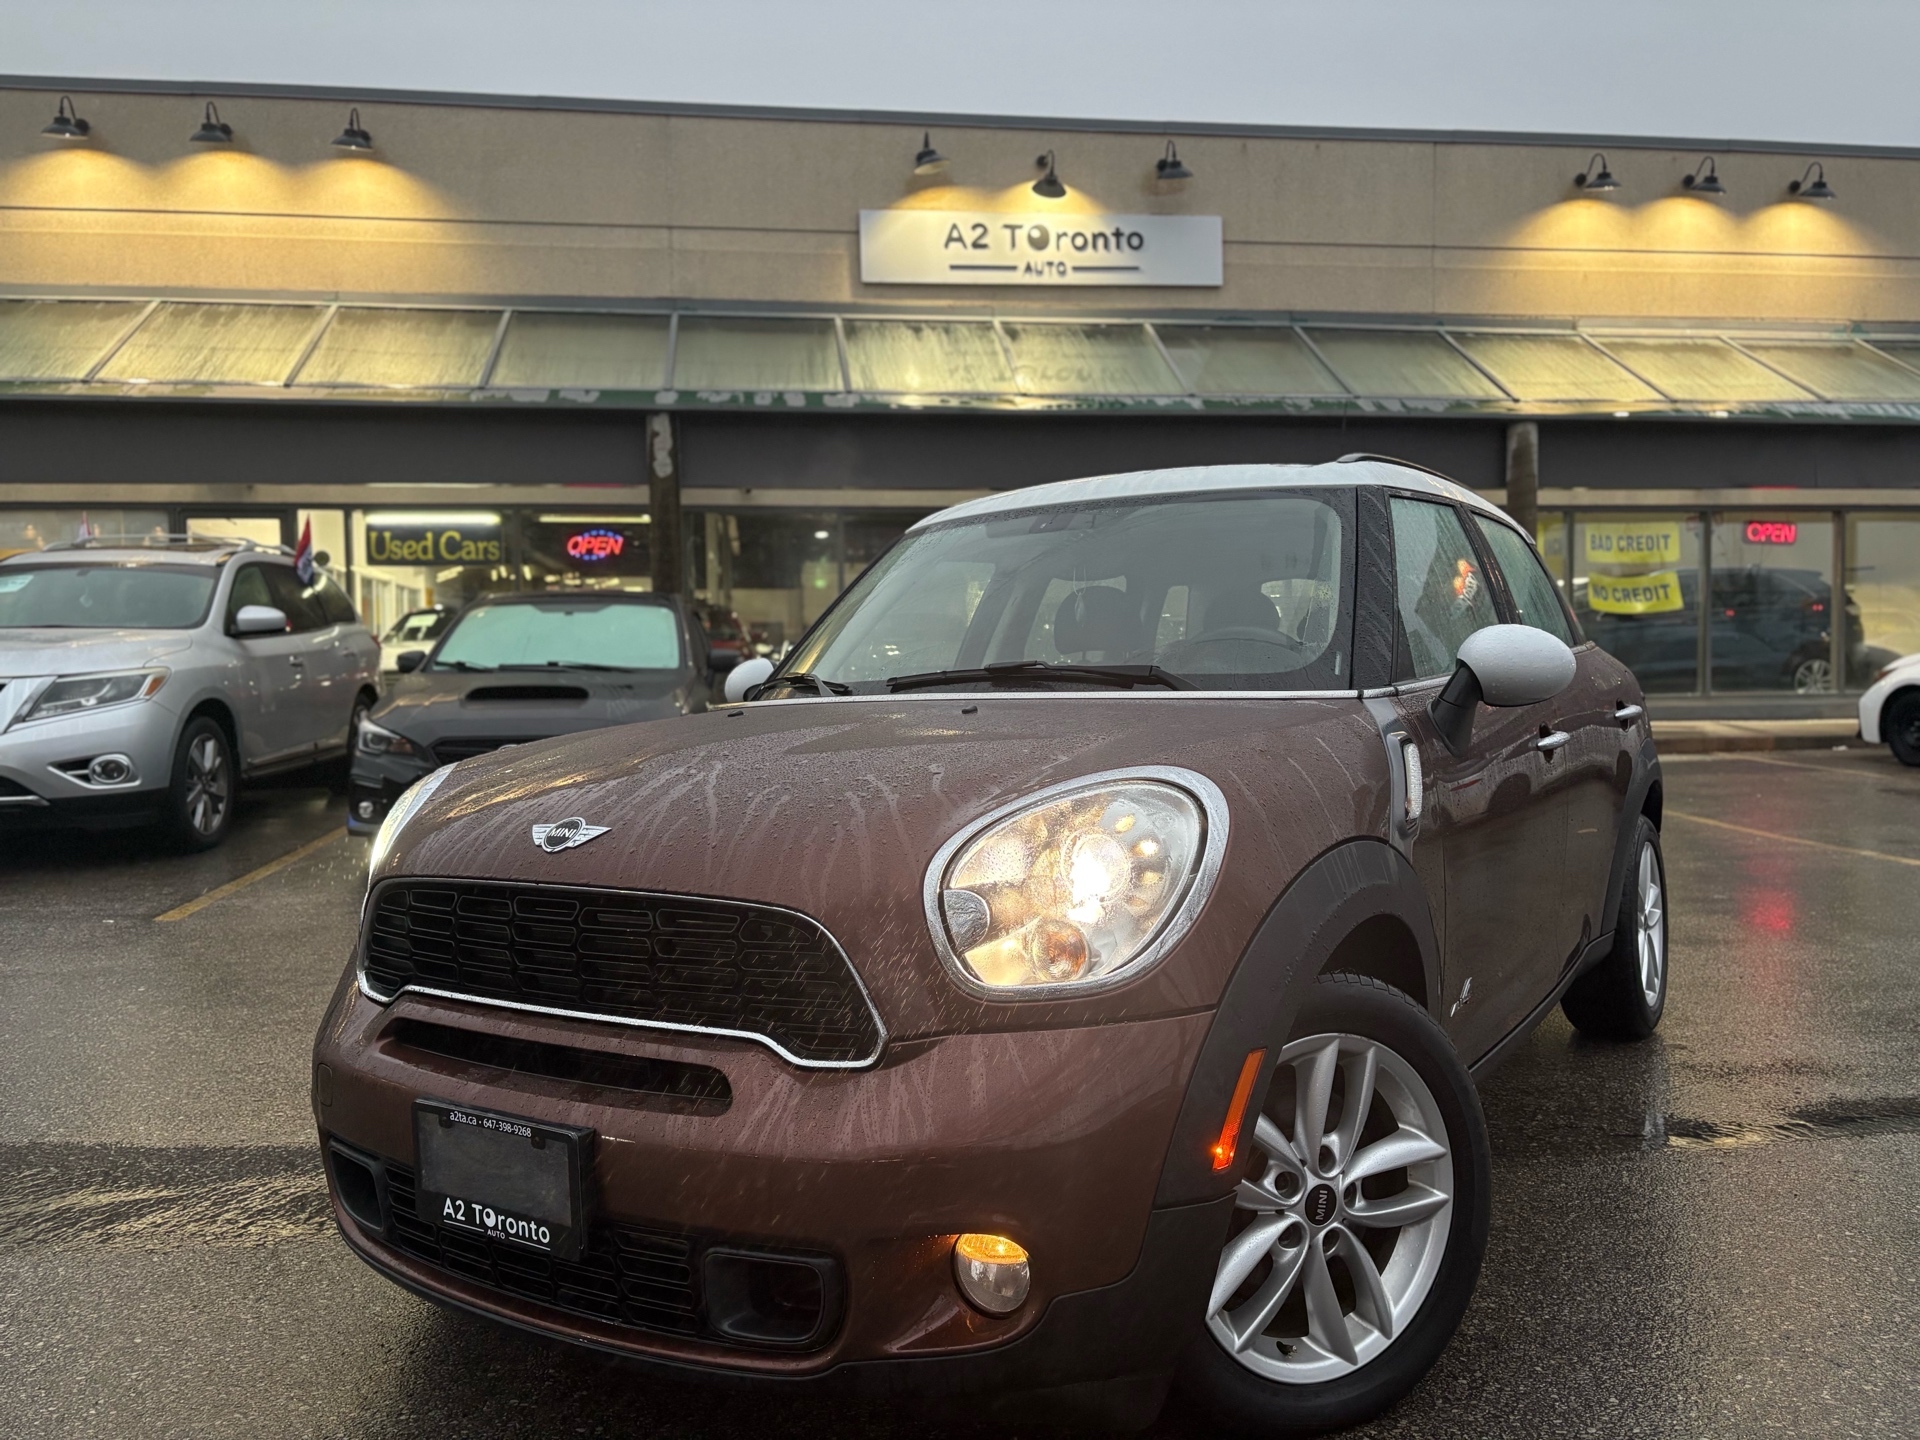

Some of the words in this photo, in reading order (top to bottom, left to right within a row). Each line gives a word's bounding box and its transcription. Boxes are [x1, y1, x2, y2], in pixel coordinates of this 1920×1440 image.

[944, 222, 989, 250] A2
[1023, 261, 1067, 278] AUTO
[1590, 533, 1613, 552] BAD
[1616, 533, 1670, 553] CREDIT
[1746, 521, 1797, 544] OPEN
[369, 530, 434, 560] Used
[439, 529, 500, 560] Cars
[566, 535, 624, 556] OPEN
[1592, 583, 1609, 601] NO
[1612, 583, 1670, 603] CREDIT
[548, 827, 577, 838] MINI
[449, 1110, 477, 1126] a2ta.ca
[483, 1118, 532, 1138] 647-398-9268
[443, 1197, 466, 1221] A2
[1315, 1190, 1328, 1220] MINI
[487, 1228, 506, 1240] AUTO
